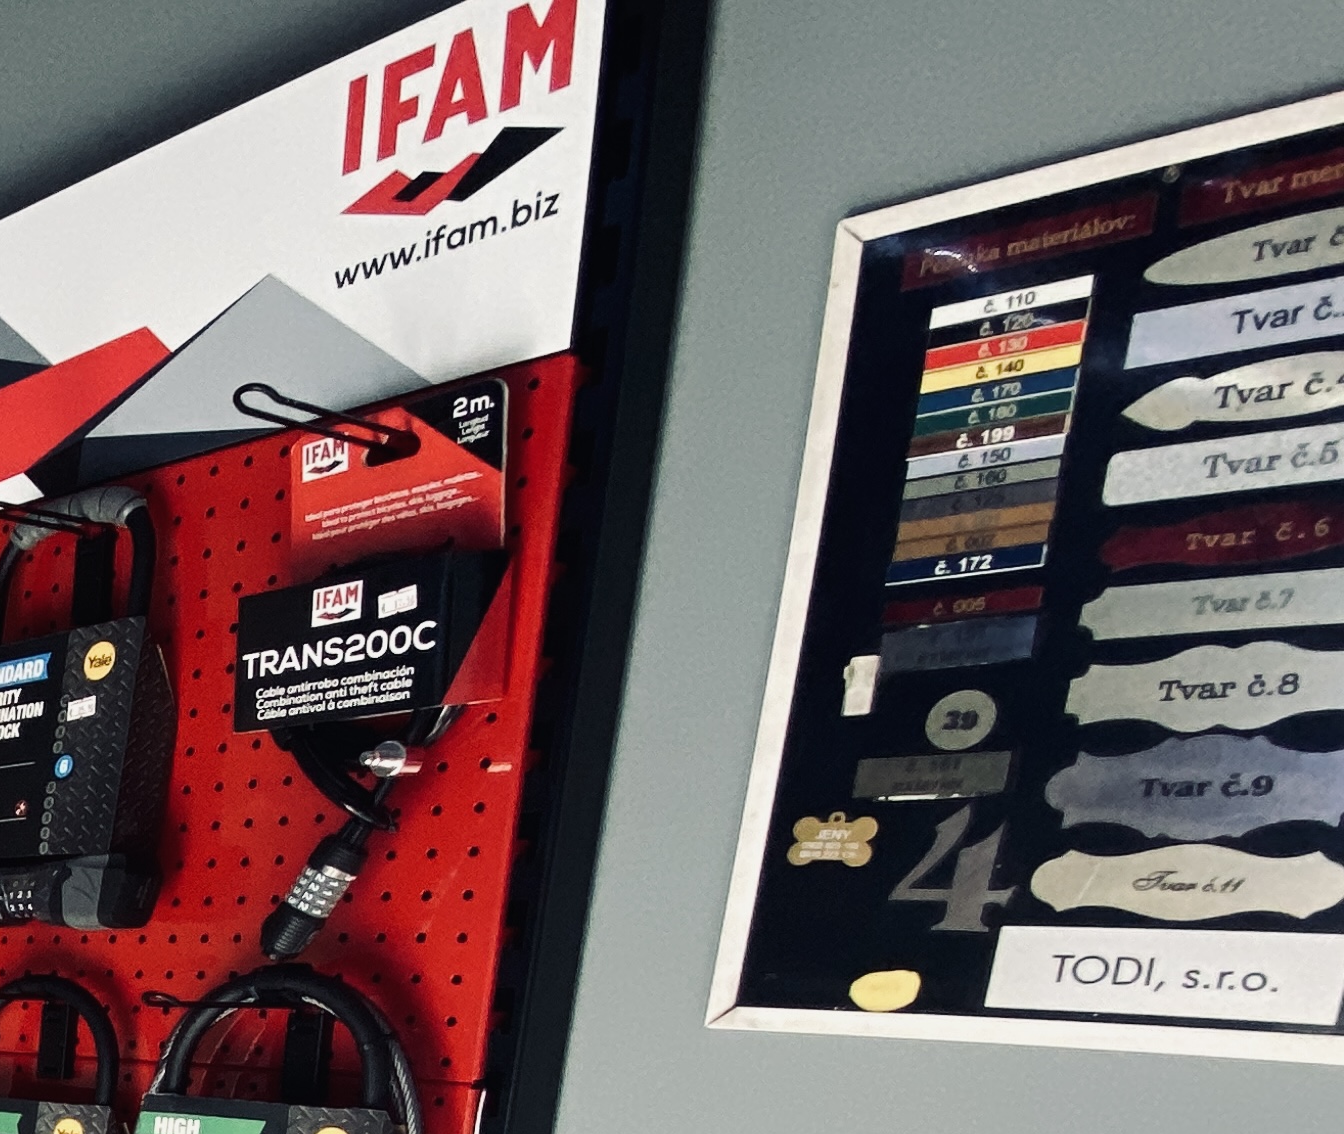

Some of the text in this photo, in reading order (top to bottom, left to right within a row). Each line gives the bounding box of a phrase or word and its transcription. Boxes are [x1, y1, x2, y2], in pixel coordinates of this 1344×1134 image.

[342, 0, 577, 175] IFAM
[1222, 177, 1284, 204] Tvar
[334, 191, 560, 288] www.ifam.biz
[1253, 234, 1317, 262] Tvar
[1007, 291, 1036, 310] 110
[1231, 304, 1306, 334] Tvar
[996, 359, 1024, 376] 140
[1214, 381, 1295, 409] Tvar
[980, 425, 1015, 445] 199
[1203, 452, 1282, 478] Tvar
[1185, 529, 1256, 550] Tvar
[958, 554, 993, 572] 172
[315, 585, 359, 610] IFAM
[88, 652, 113, 671] Yale
[242, 620, 438, 679] TRANS200C
[255, 665, 415, 699] Cable antirrobo combinación
[256, 692, 324, 709] Combination
[349, 681, 379, 696] theft
[380, 678, 413, 692] cable
[1159, 672, 1299, 701] Tvar č.8
[1140, 772, 1275, 798] Tvar č.9
[887, 804, 1018, 933] 4
[1052, 954, 1279, 992] TODI, s.r.o.
